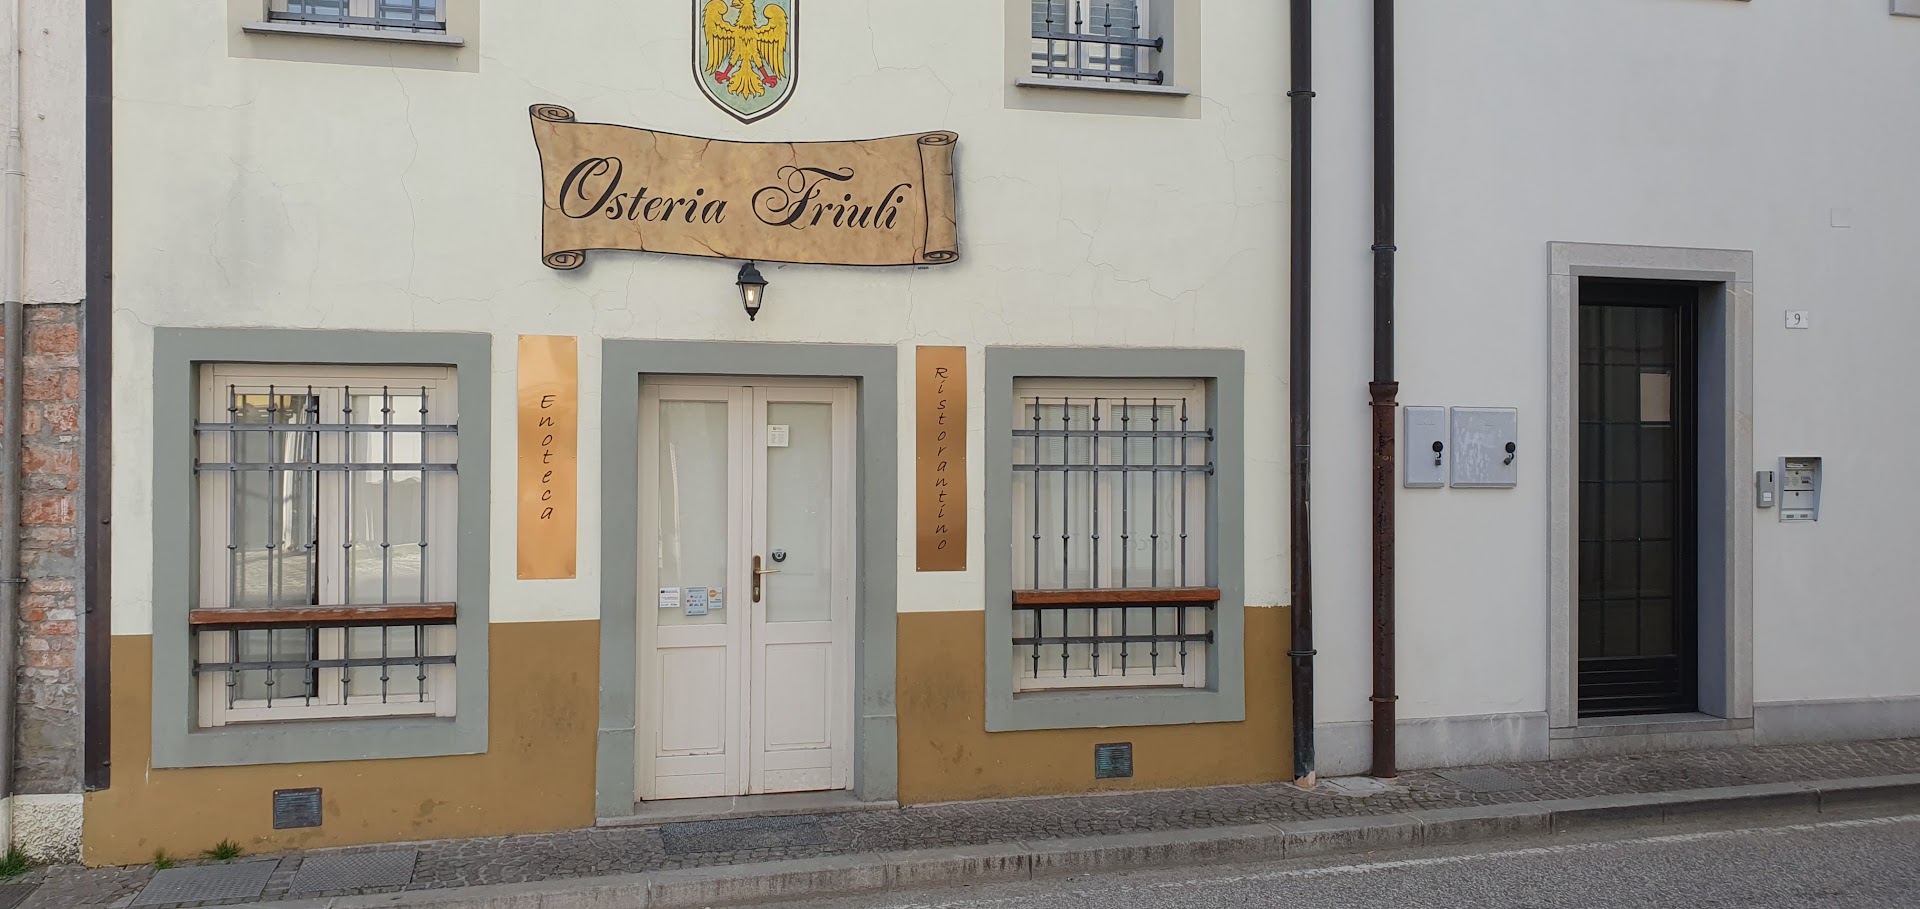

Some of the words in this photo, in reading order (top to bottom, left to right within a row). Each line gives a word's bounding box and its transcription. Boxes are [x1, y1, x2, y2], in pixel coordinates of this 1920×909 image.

[559, 156, 726, 224] Osteria
[751, 165, 912, 230] Friuli
[1794, 313, 1801, 326] 9
[538, 394, 556, 520] Enoteca
[934, 367, 949, 550] Ristorantino
